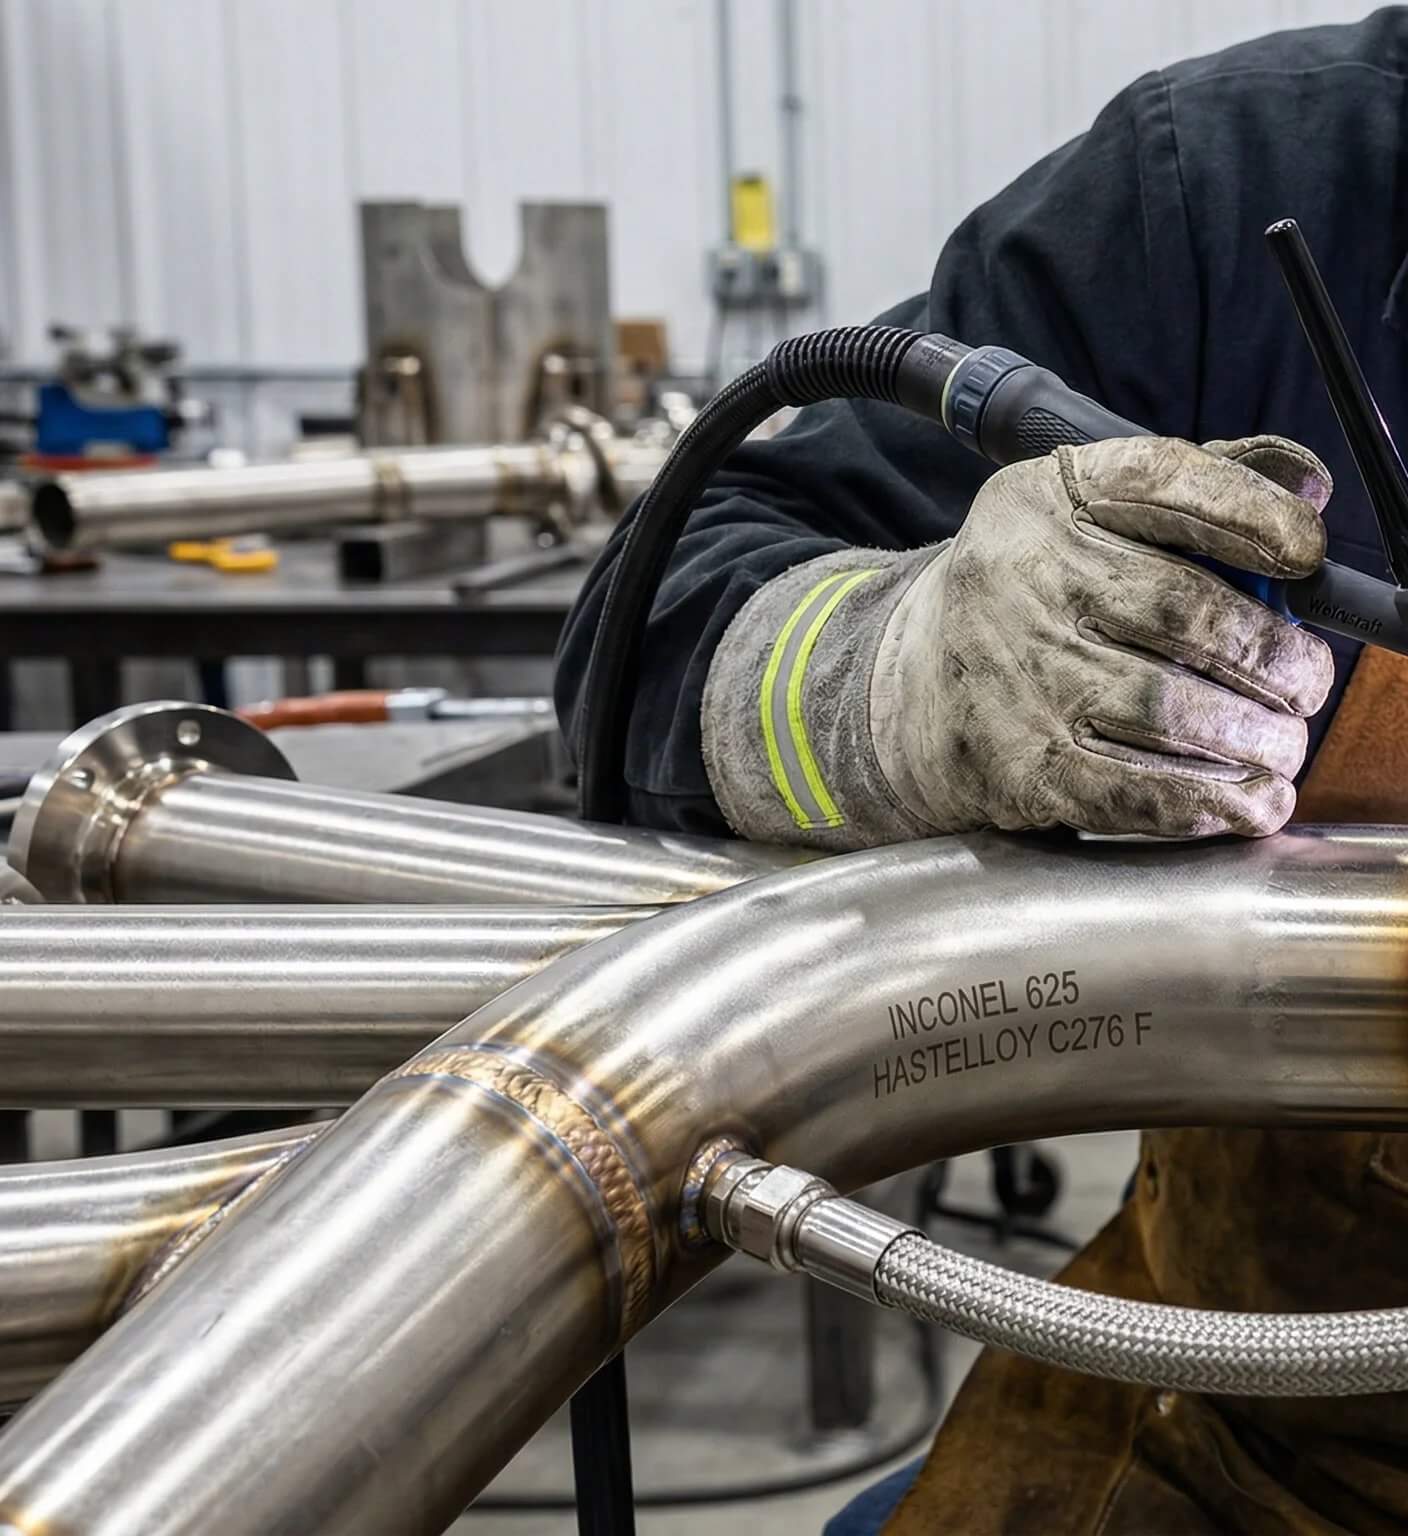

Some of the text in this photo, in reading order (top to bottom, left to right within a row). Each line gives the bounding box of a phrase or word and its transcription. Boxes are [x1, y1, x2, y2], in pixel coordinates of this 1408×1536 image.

[888, 969, 1080, 1041] INCONEL 625
[873, 1011, 1153, 1099] HASTELLOY C276 F
